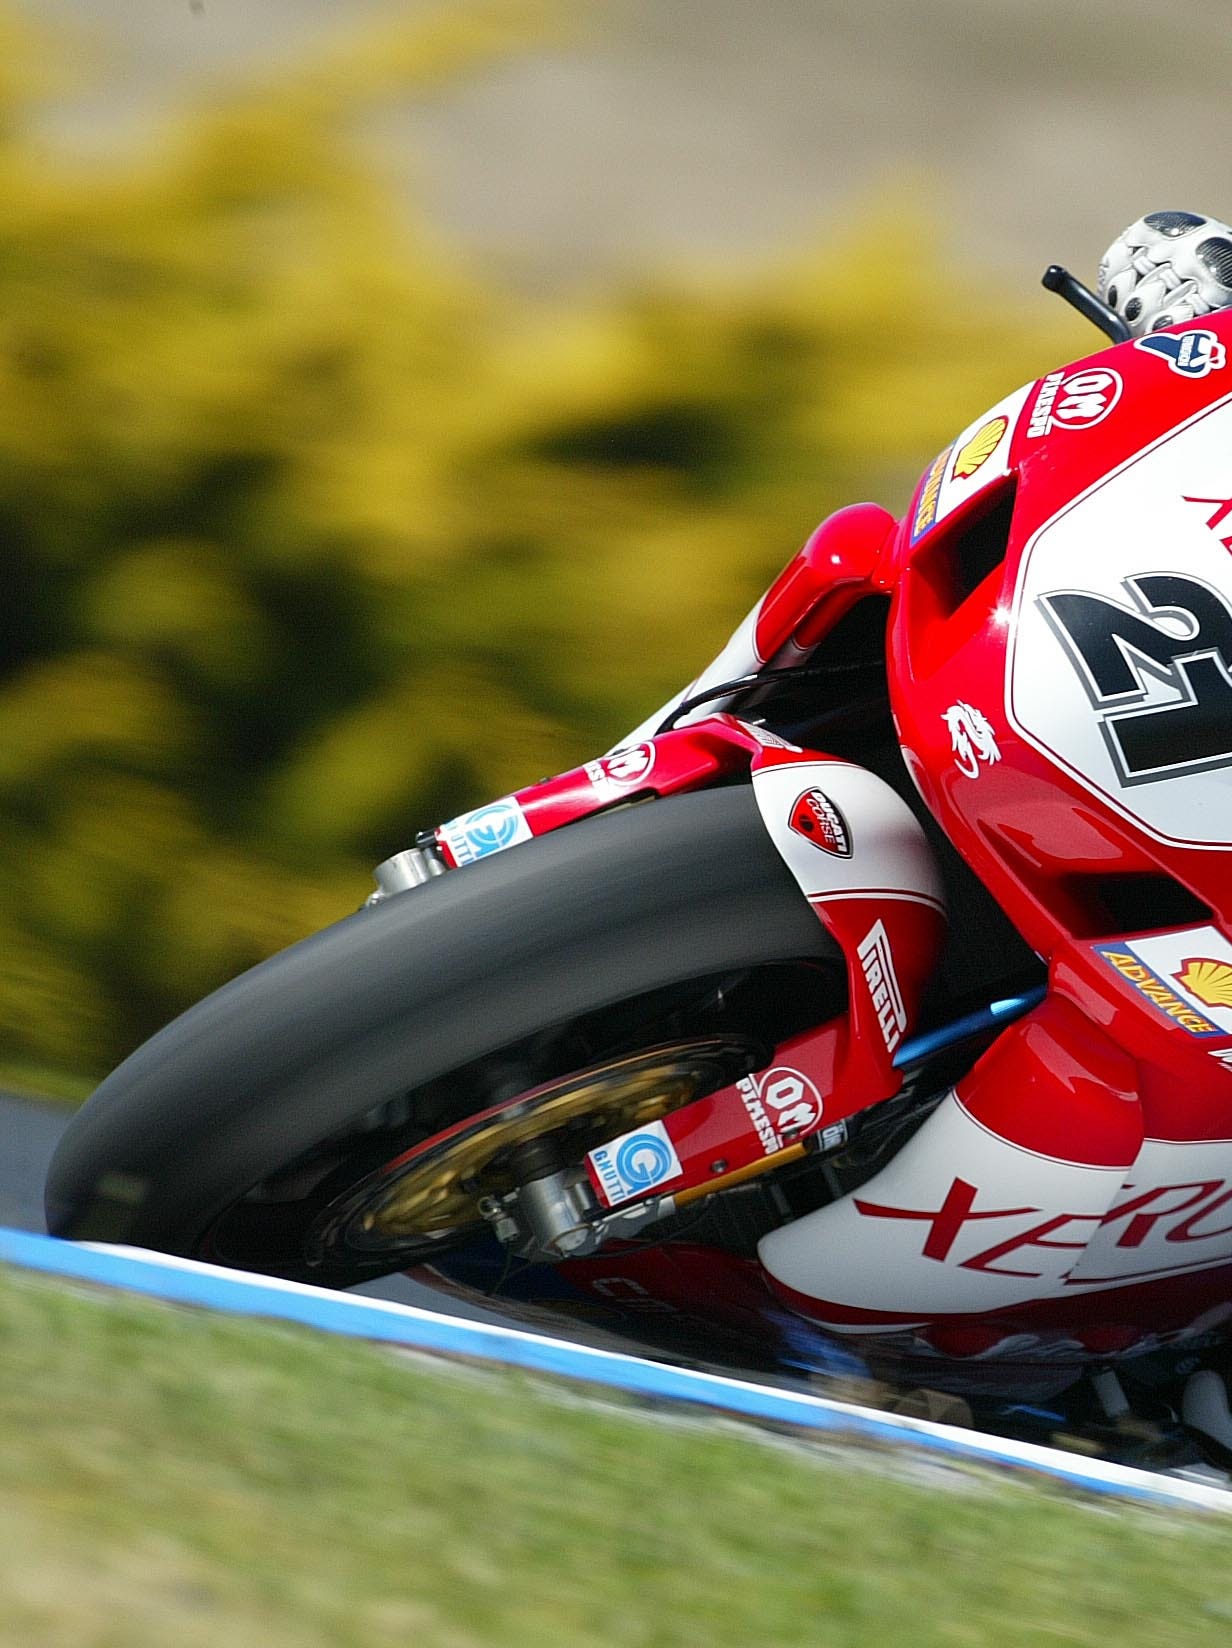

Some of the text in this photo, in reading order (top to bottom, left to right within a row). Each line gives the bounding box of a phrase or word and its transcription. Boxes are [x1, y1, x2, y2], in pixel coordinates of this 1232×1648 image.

[809, 791, 849, 853] DUCATI
[856, 917, 908, 1054] PIRELLI
[1101, 950, 1219, 1034] ADVANCE
